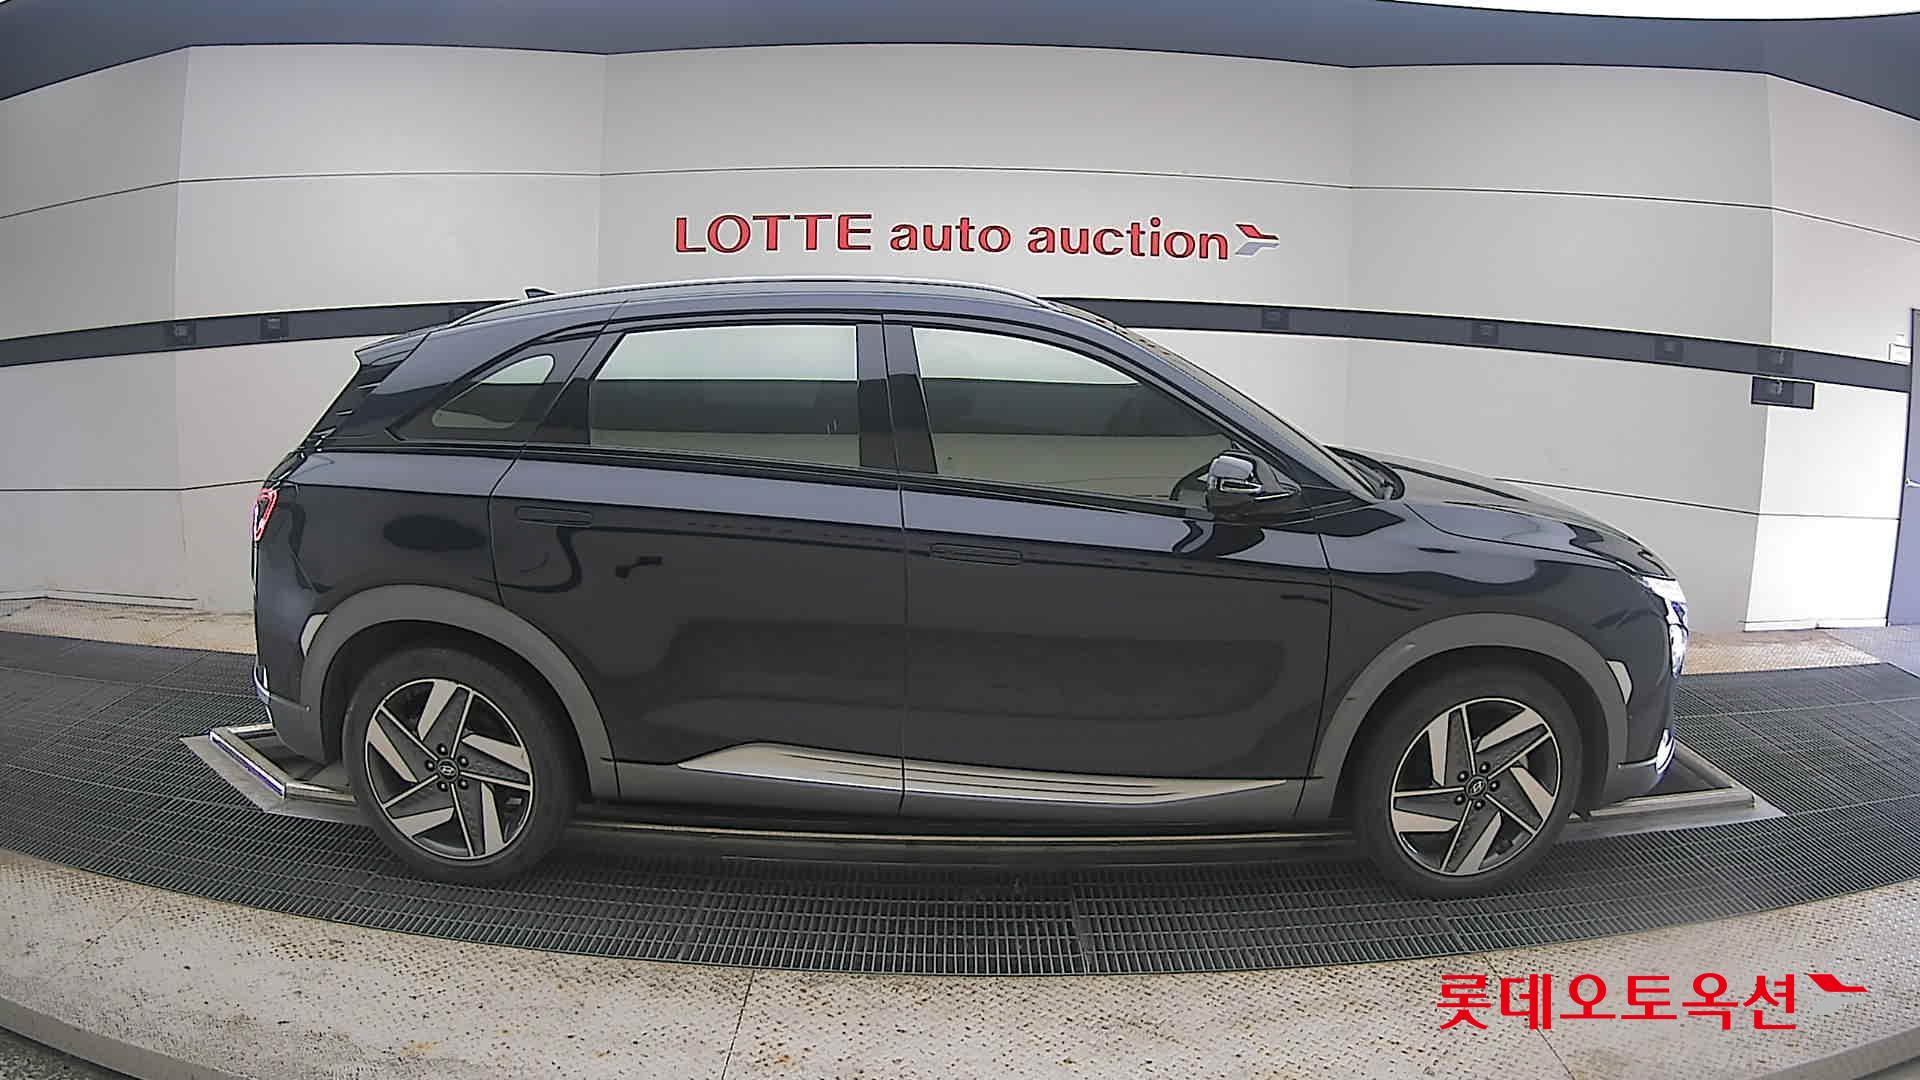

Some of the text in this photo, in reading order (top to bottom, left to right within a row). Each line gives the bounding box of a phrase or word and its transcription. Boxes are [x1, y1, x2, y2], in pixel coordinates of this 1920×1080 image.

[675, 214, 1229, 260] LOTTE auto auction
